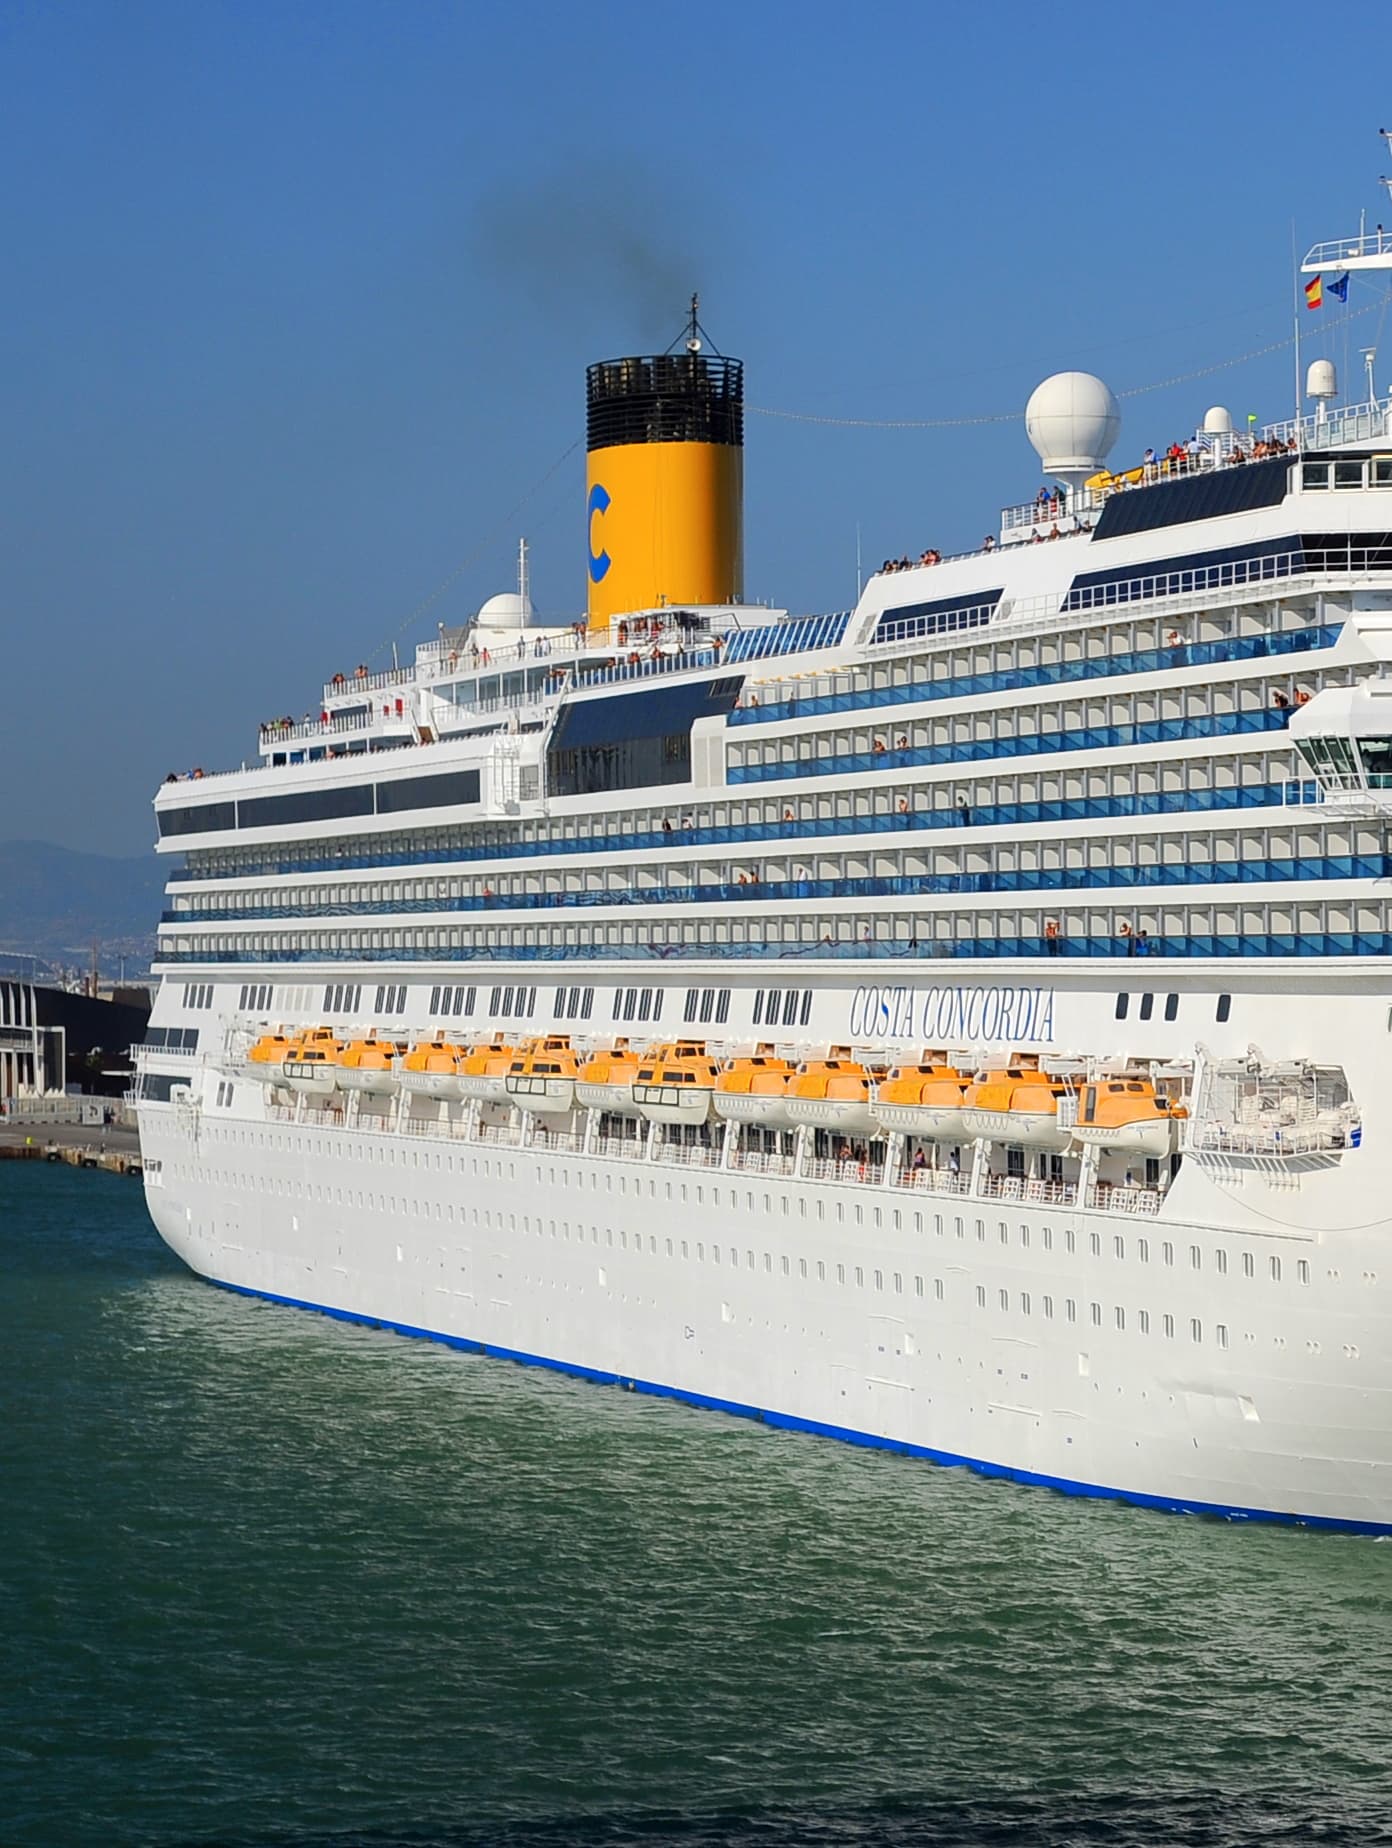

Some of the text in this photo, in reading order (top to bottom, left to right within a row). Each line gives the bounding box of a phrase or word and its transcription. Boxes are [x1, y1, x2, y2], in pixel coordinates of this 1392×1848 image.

[588, 483, 612, 584] C
[850, 985, 1055, 1042] COSTA CONCORDIA
